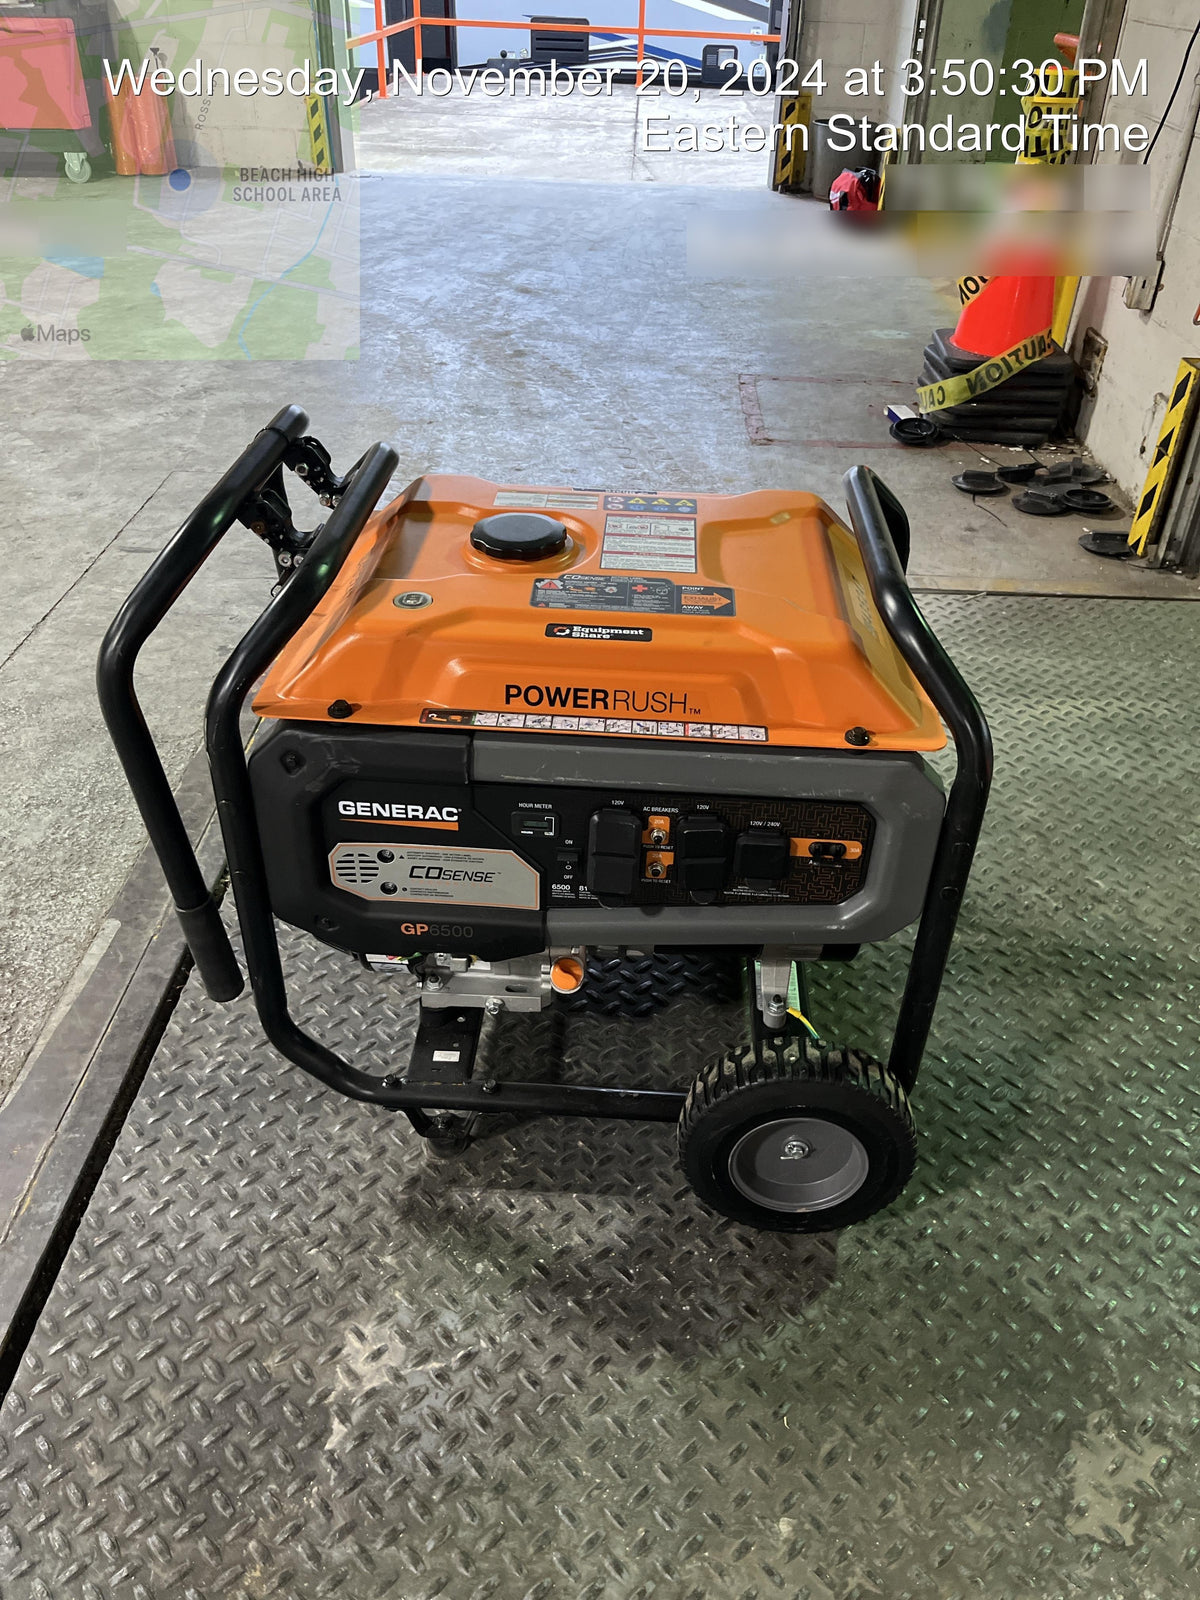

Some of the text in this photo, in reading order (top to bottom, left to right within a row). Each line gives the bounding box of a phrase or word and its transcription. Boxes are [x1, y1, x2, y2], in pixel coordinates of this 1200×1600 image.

[572, 626, 644, 636] Equipment
[571, 632, 611, 640] Share
[338, 800, 459, 821] GENERAC
[651, 806, 679, 814] BREAKERS
[551, 883, 571, 891] 6500
[400, 922, 474, 938] GP6500
